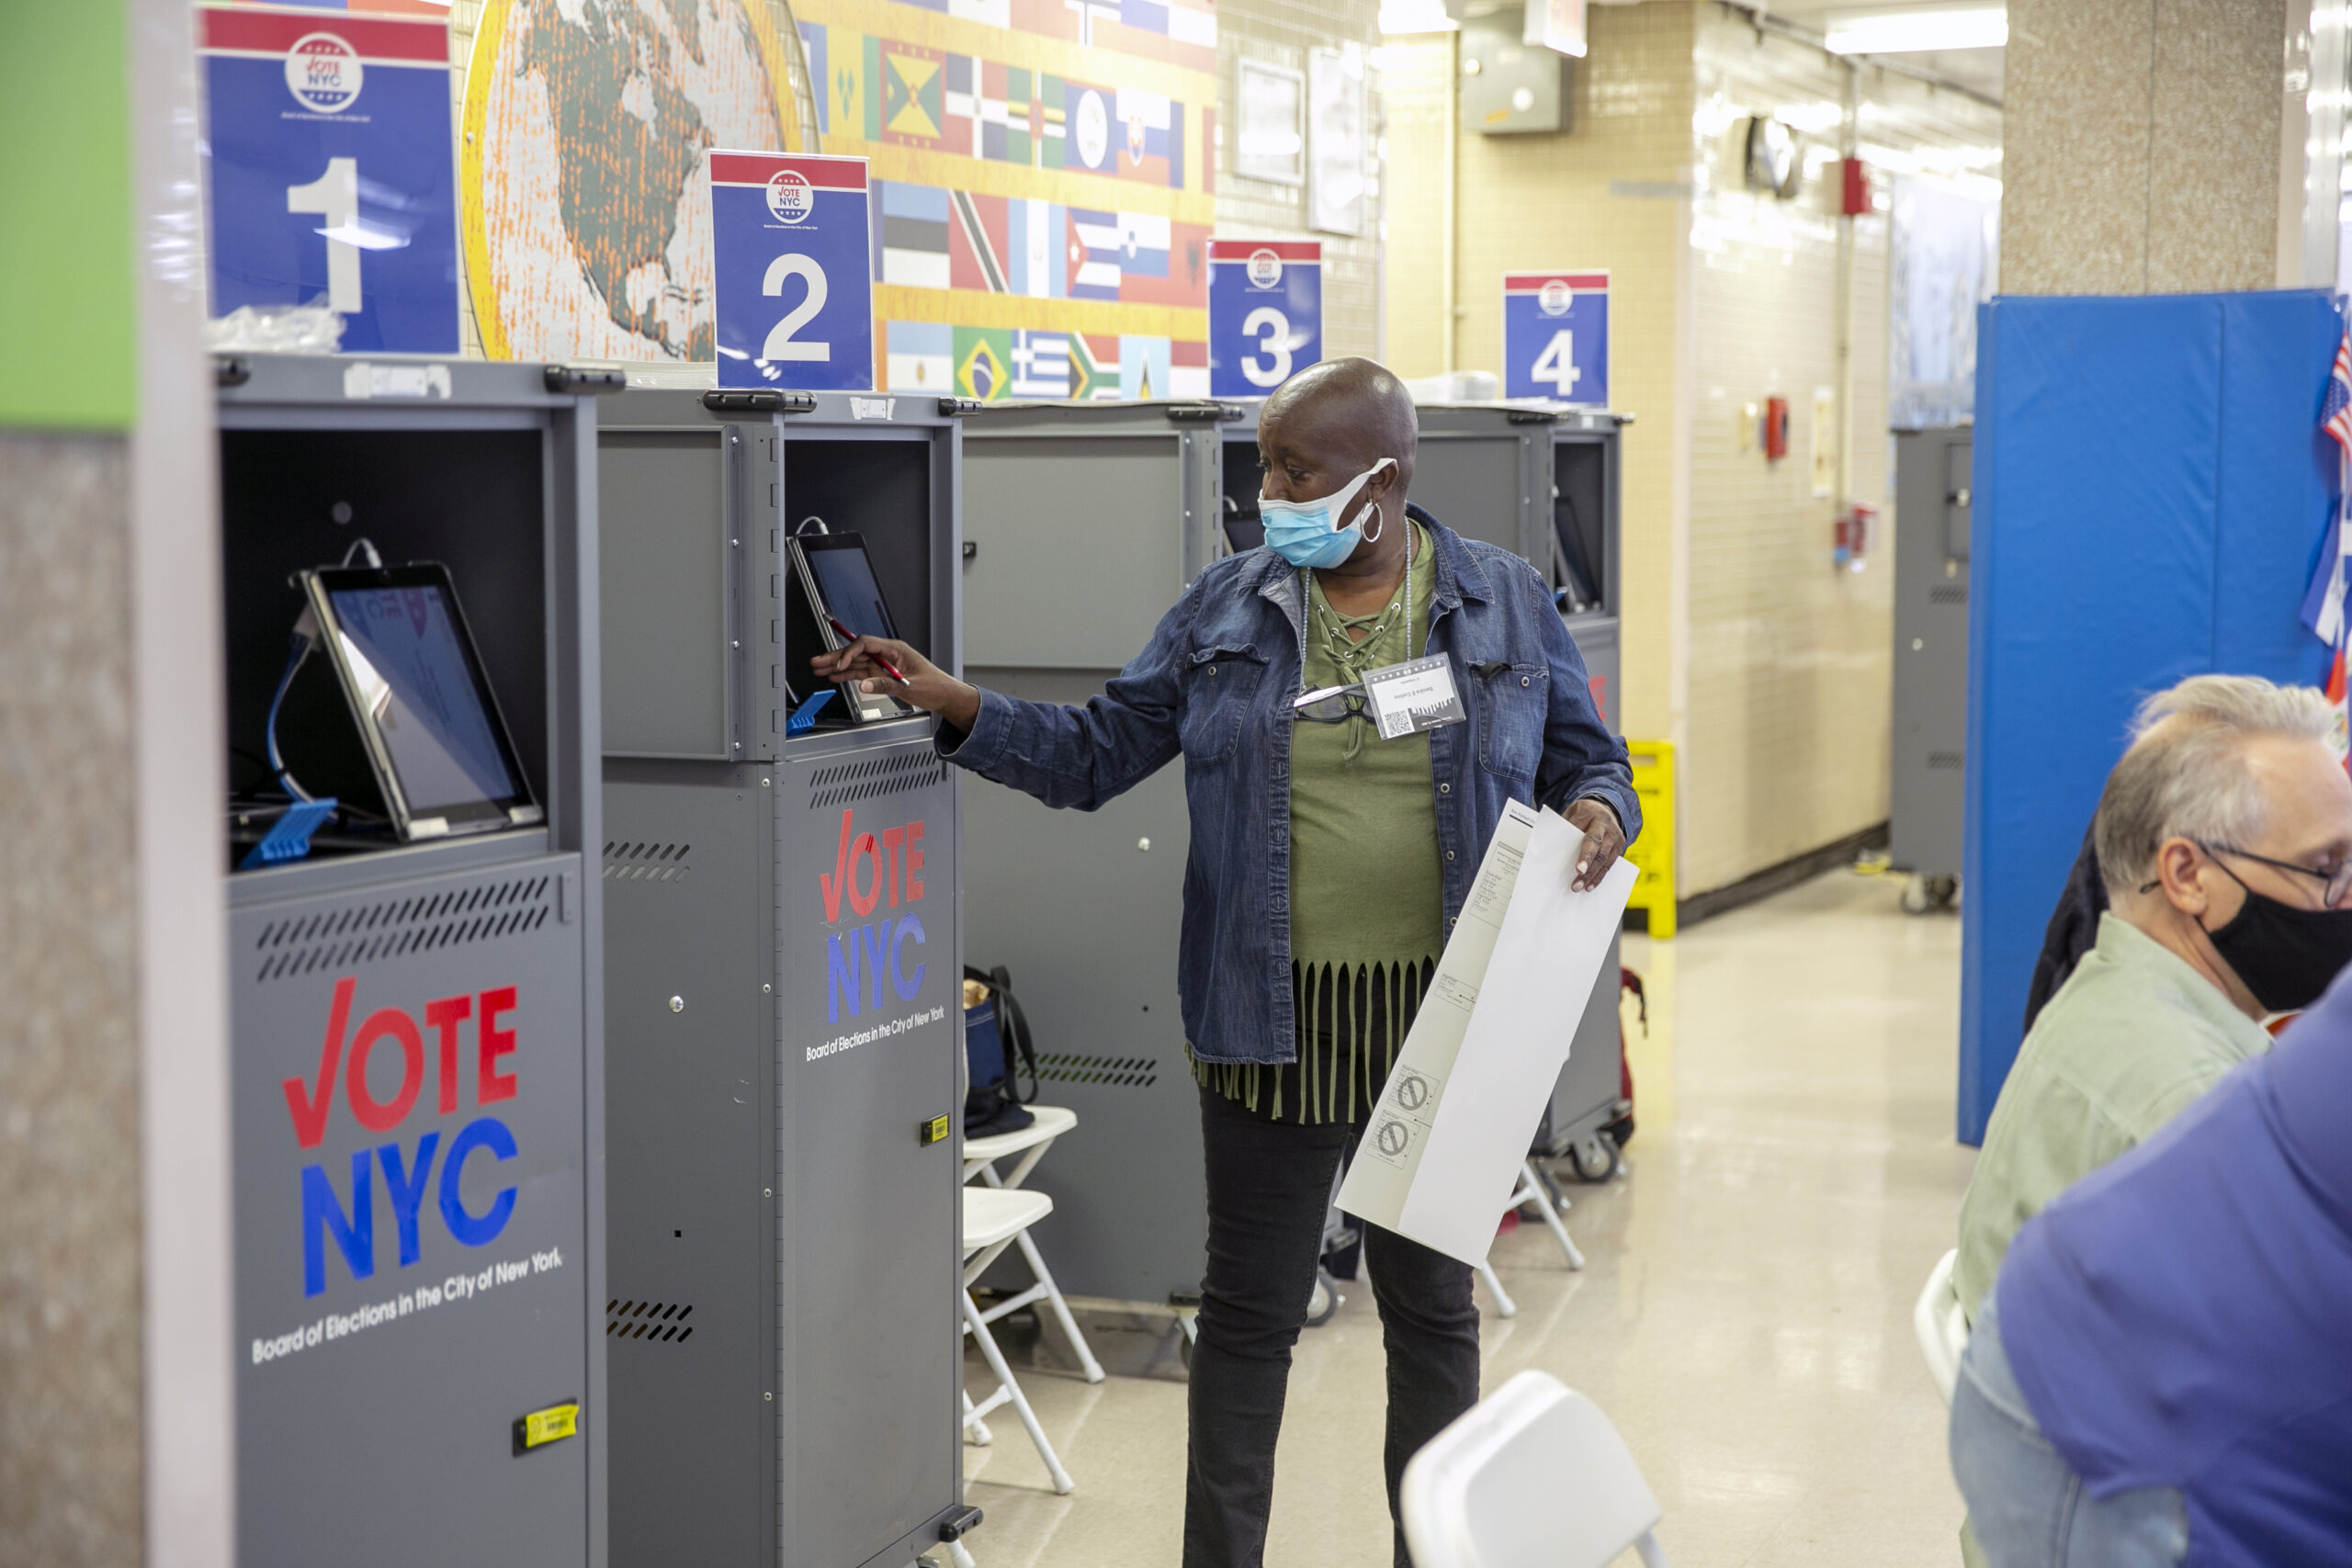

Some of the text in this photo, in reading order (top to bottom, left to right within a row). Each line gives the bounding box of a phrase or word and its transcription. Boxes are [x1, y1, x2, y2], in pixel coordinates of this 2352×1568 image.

[308, 73, 342, 87] NYC
[287, 157, 362, 313] 1
[777, 186, 800, 197] VOTE
[779, 197, 801, 207] NYC
[763, 254, 830, 362] 2
[1241, 307, 1293, 388] 3
[1531, 329, 1581, 397] 4
[820, 809, 925, 923] VOTE
[828, 913, 926, 1024] NYC
[282, 976, 517, 1150] VOTE
[806, 1005, 944, 1062] Board of Elections in the City of New York
[300, 1117, 518, 1299] NYC
[252, 1327, 304, 1365] Board
[305, 1318, 322, 1348] of
[325, 1299, 397, 1340] Elections
[399, 1292, 413, 1316] in
[415, 1285, 442, 1311] the
[444, 1272, 475, 1301] City
[477, 1266, 494, 1291] of
[496, 1260, 528, 1286] New
